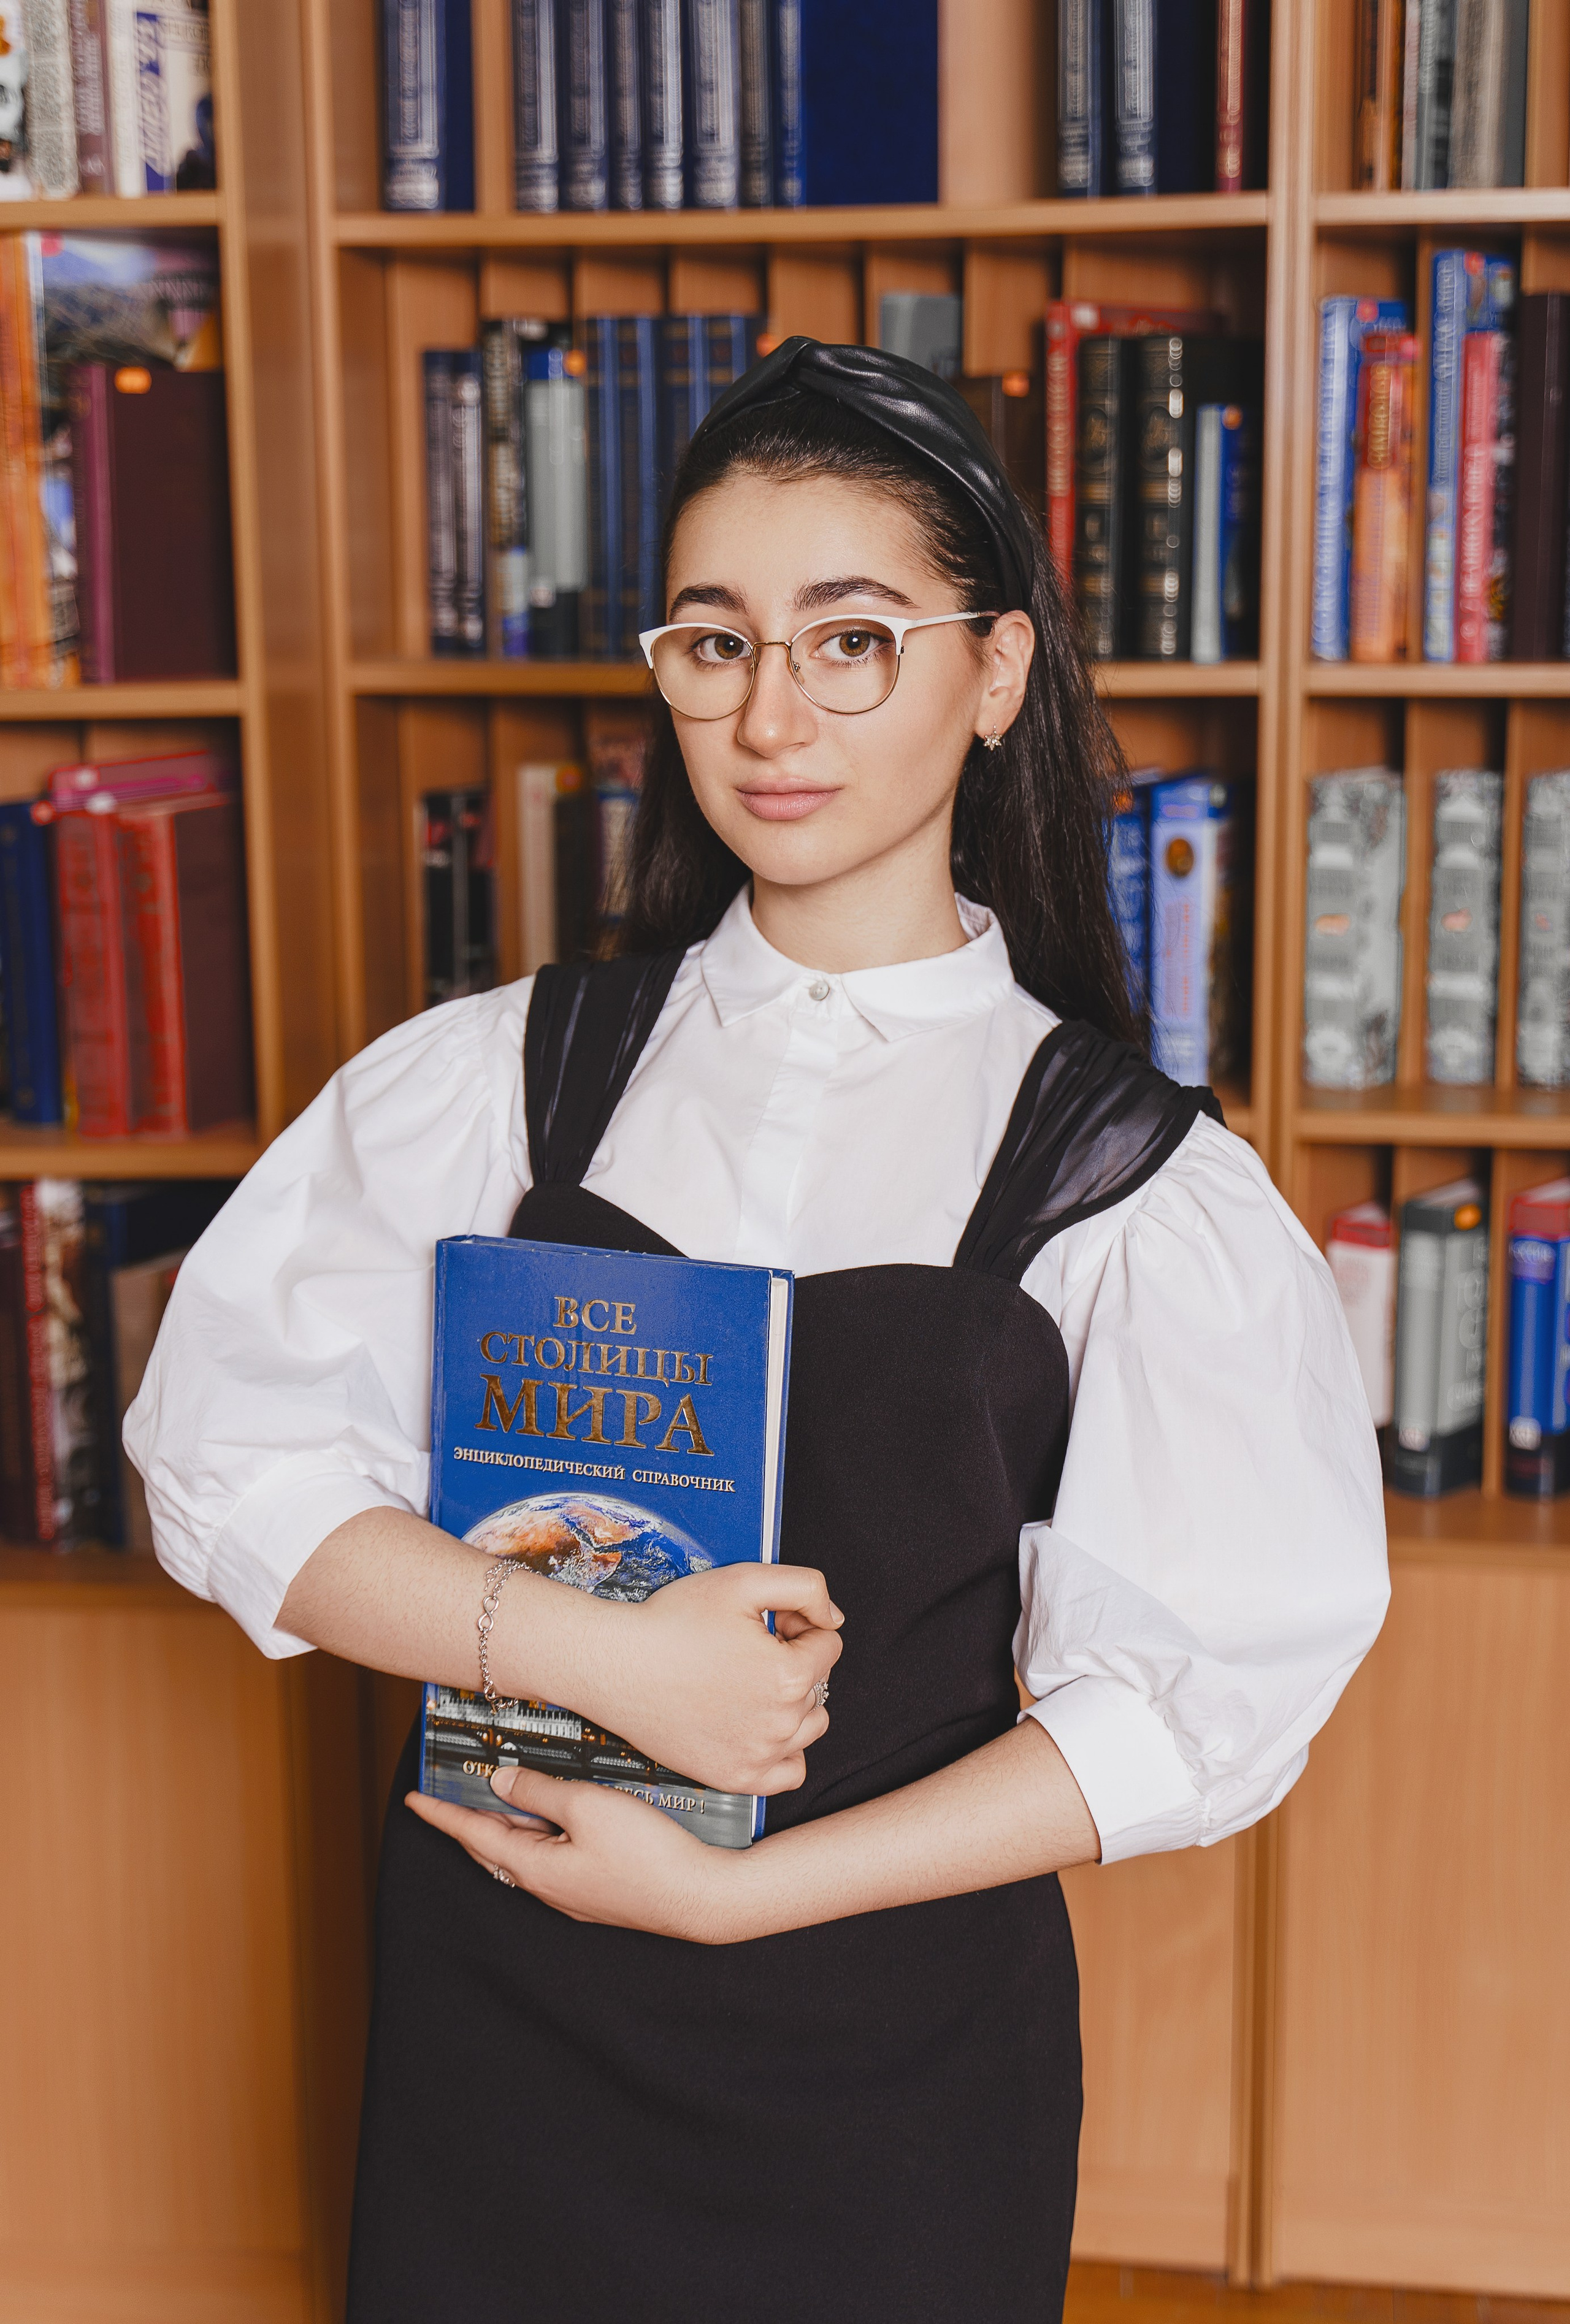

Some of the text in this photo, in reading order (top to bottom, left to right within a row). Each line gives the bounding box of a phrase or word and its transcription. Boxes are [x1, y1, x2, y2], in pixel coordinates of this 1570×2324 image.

[553, 1296, 637, 1335] ВСЕ
[480, 1331, 713, 1387] СТОЛИЦЫ
[474, 1374, 714, 1456] МИРА
[453, 1447, 735, 1493] ЭНЦИКЛОПЕДИЧЕСКИЙ СПРАВОЧНИК
